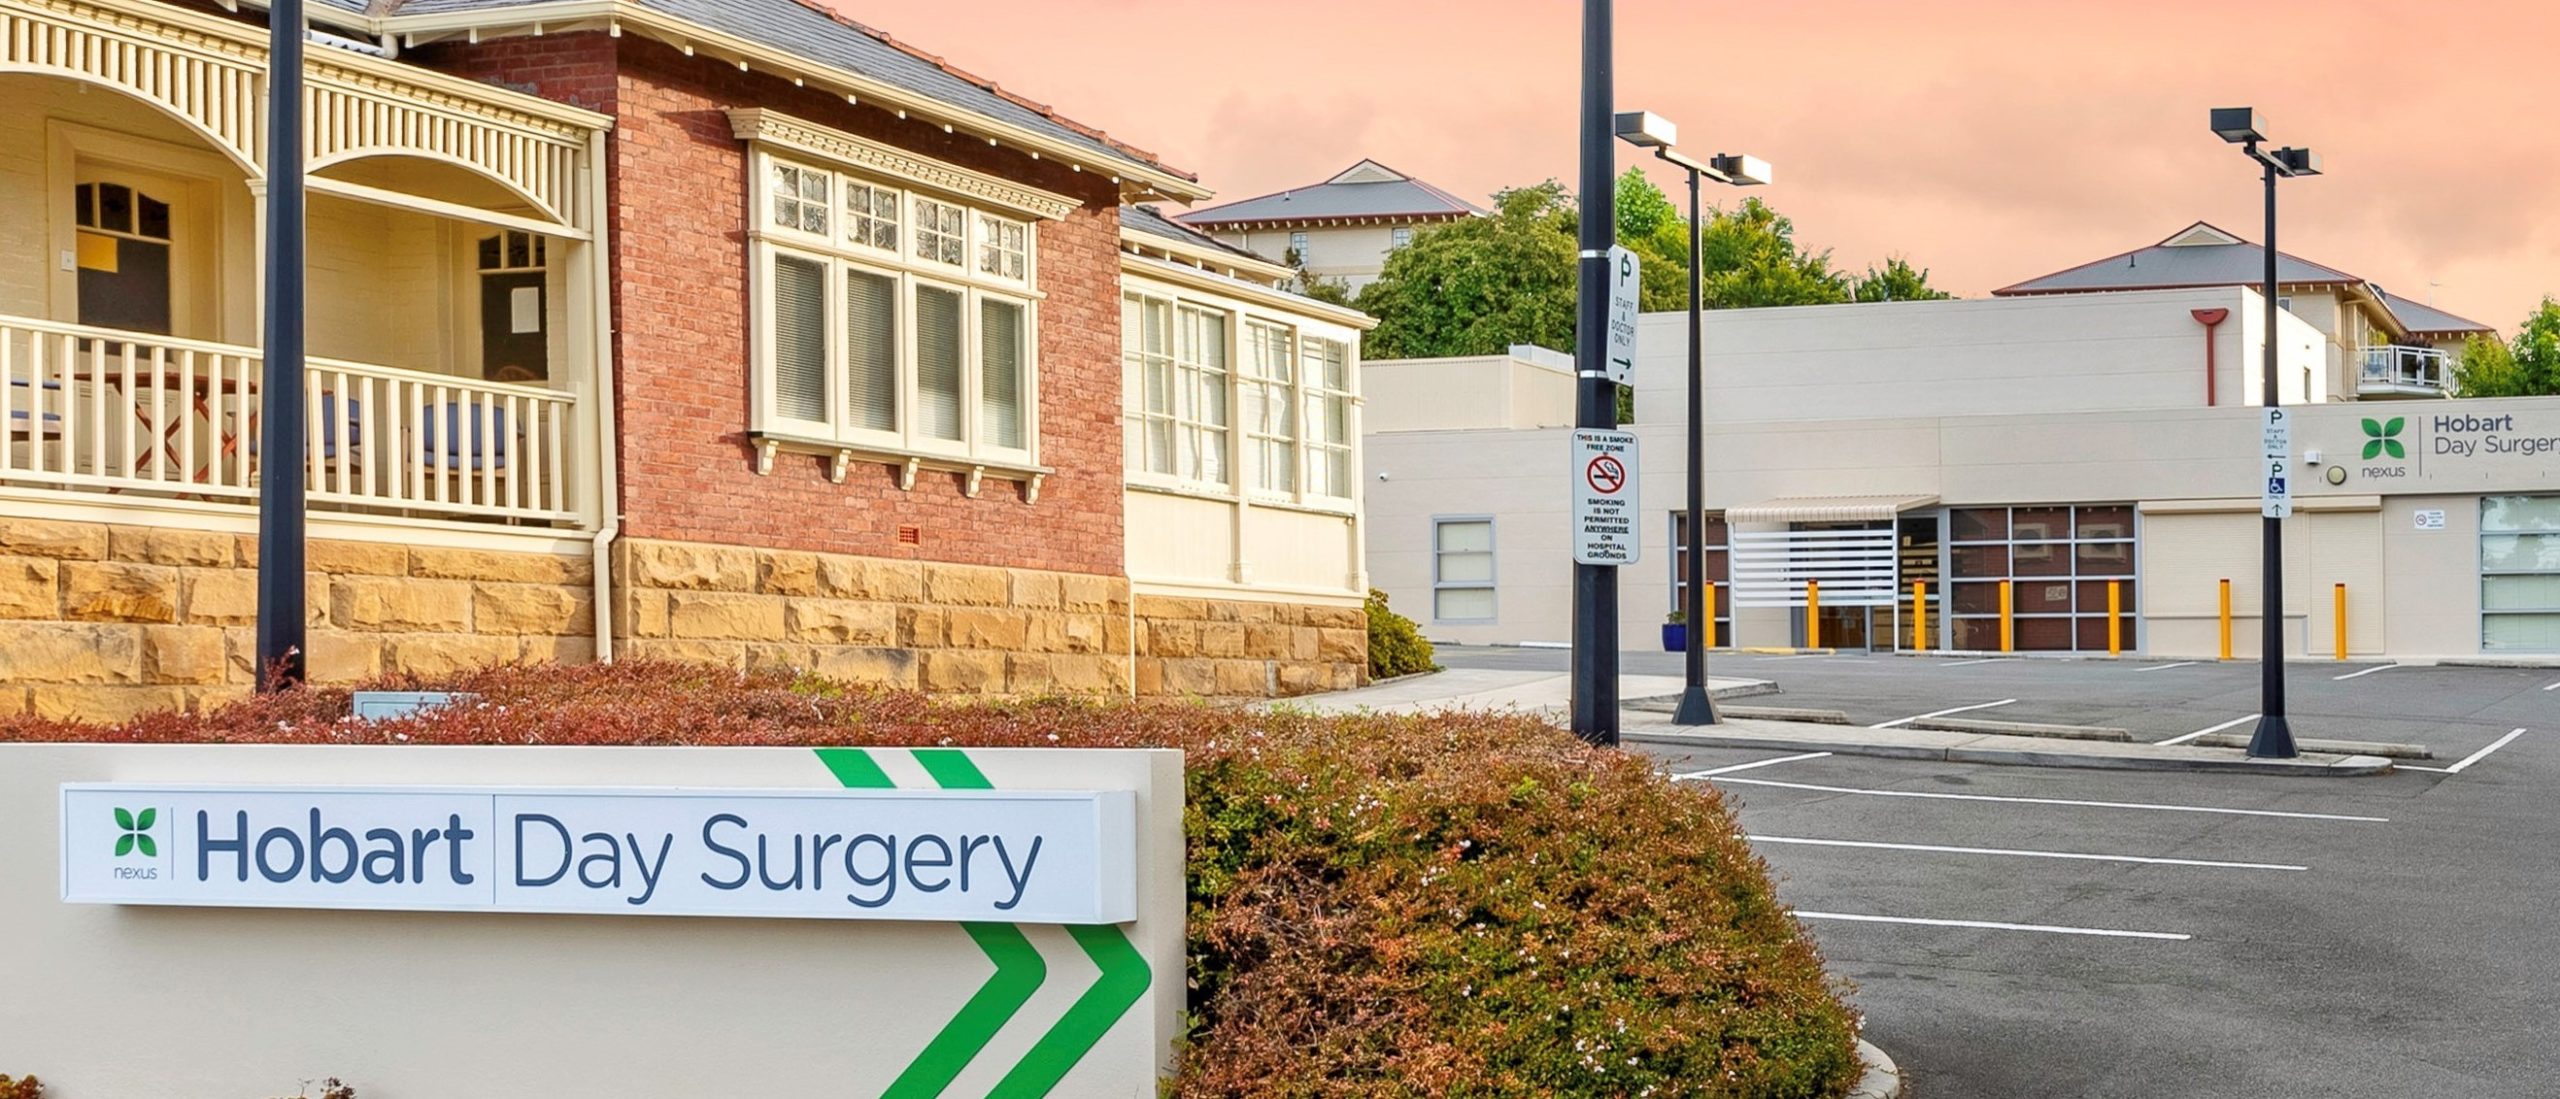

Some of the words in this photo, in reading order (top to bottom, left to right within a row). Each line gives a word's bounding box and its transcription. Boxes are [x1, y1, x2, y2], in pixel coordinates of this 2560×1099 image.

[1620, 254, 1632, 287] P
[1615, 296, 1634, 311] STAFF
[1611, 319, 1635, 336] DOCTOR
[1614, 332, 1631, 347] ONLY
[2434, 414, 2513, 433] Hobart
[1577, 434, 1593, 442] THIS
[1609, 436, 1634, 444] SMOKE
[2434, 436, 2477, 457] Day
[2485, 435, 2560, 457] Surger
[2362, 466, 2406, 479] nexus
[1587, 498, 1626, 506] SMOKING
[1584, 516, 1630, 524] PERMITTED
[1584, 525, 1630, 534] ANYWHERE
[1587, 543, 1627, 551] HOSPITAL
[1587, 551, 1628, 560] GROUNDS
[197, 807, 475, 885] Hobart
[515, 813, 673, 905] Day
[700, 813, 1043, 910] Surgery
[114, 867, 158, 880] nexus
